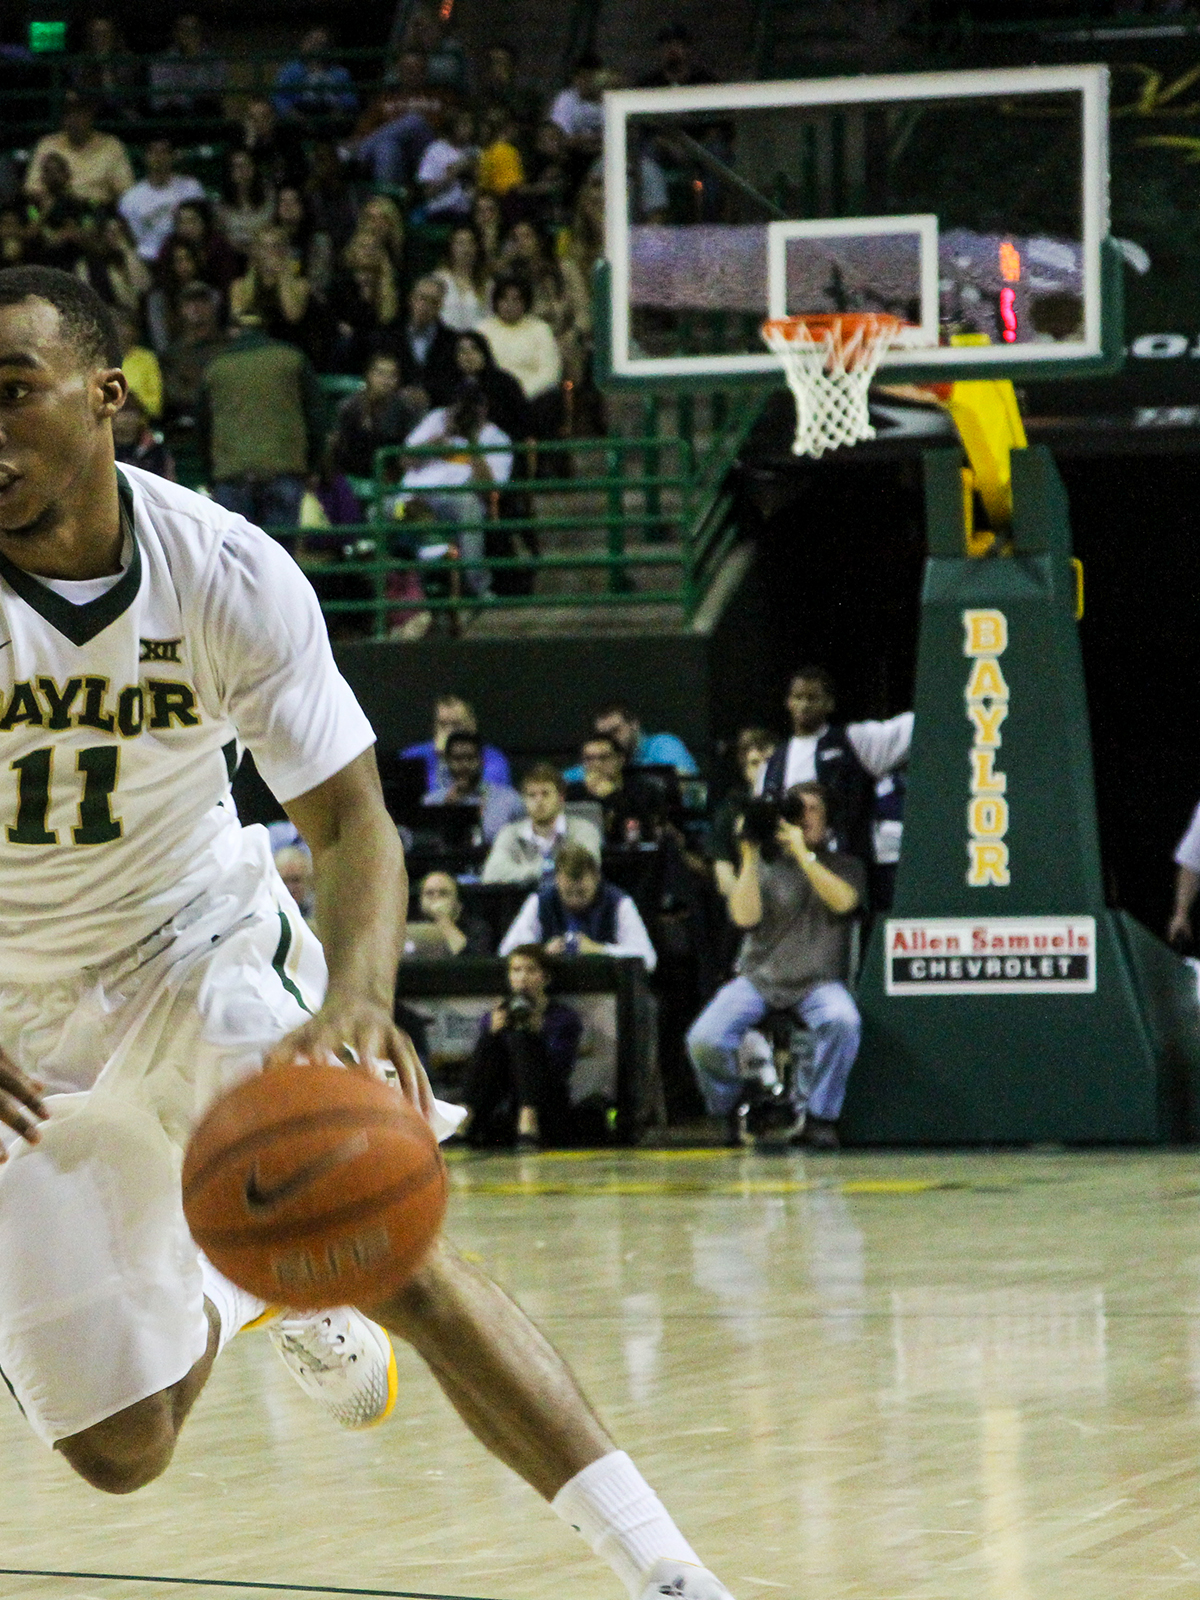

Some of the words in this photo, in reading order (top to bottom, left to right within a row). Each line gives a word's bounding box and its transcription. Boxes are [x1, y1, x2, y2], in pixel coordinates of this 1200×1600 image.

[963, 609, 1010, 887] BAYLOR
[5, 745, 123, 846] 11
[893, 929, 960, 950] Allen
[972, 925, 1088, 950] Samuels
[910, 957, 1072, 979] CHEVROLET
